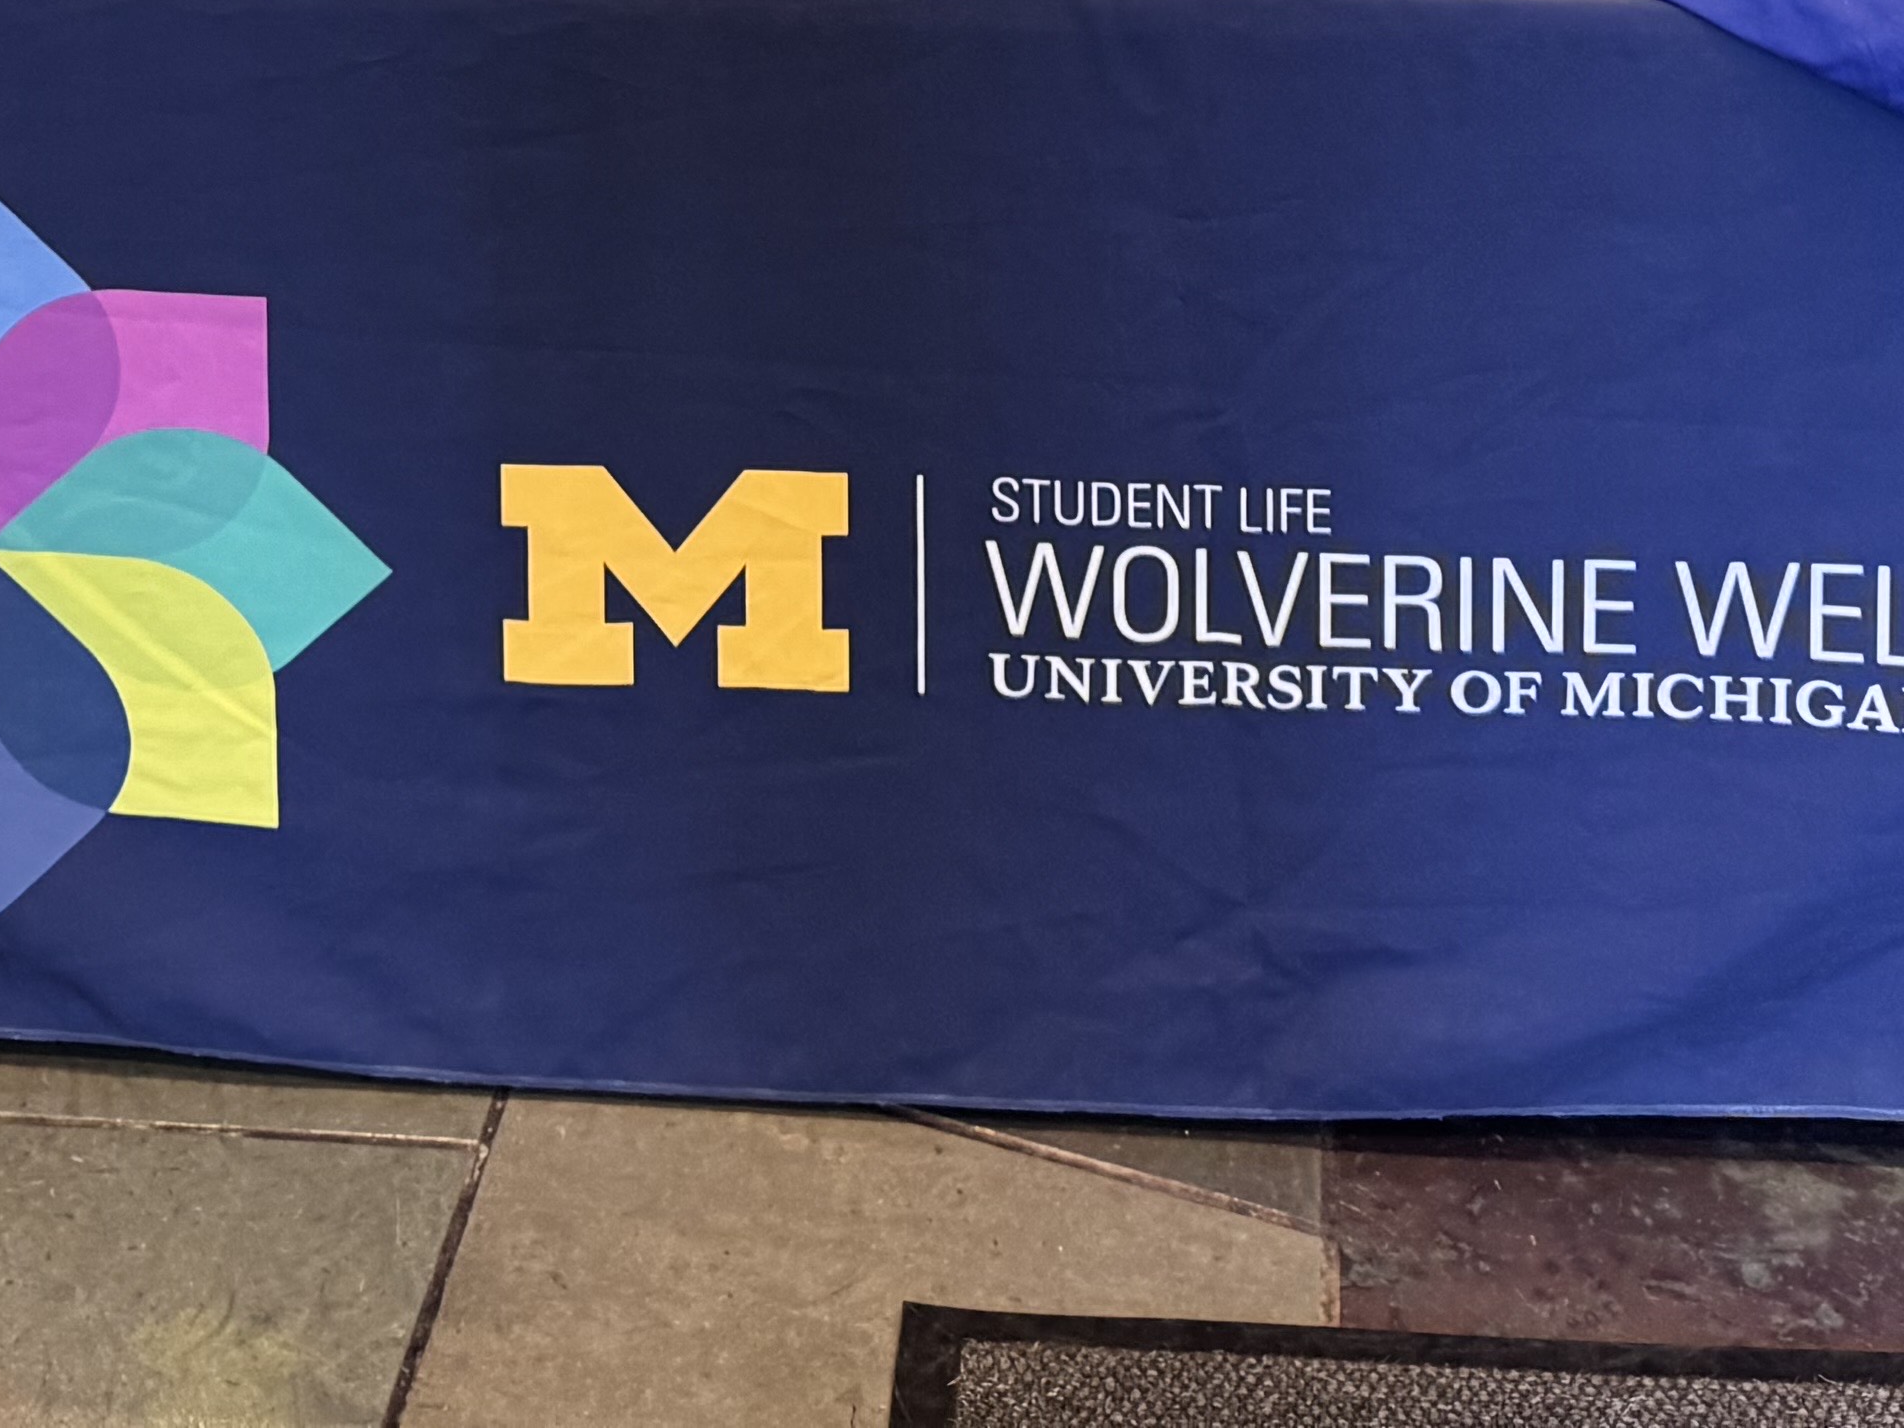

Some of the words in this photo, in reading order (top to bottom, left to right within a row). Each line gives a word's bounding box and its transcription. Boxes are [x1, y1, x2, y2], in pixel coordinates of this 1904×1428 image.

[991, 477, 1223, 532] STUDENT
[1239, 487, 1333, 536] LIFE
[501, 464, 849, 692] M
[986, 540, 1637, 657] WOLVERINE
[989, 652, 1431, 713] UNIVERSITY
[1450, 668, 1543, 717] OF
